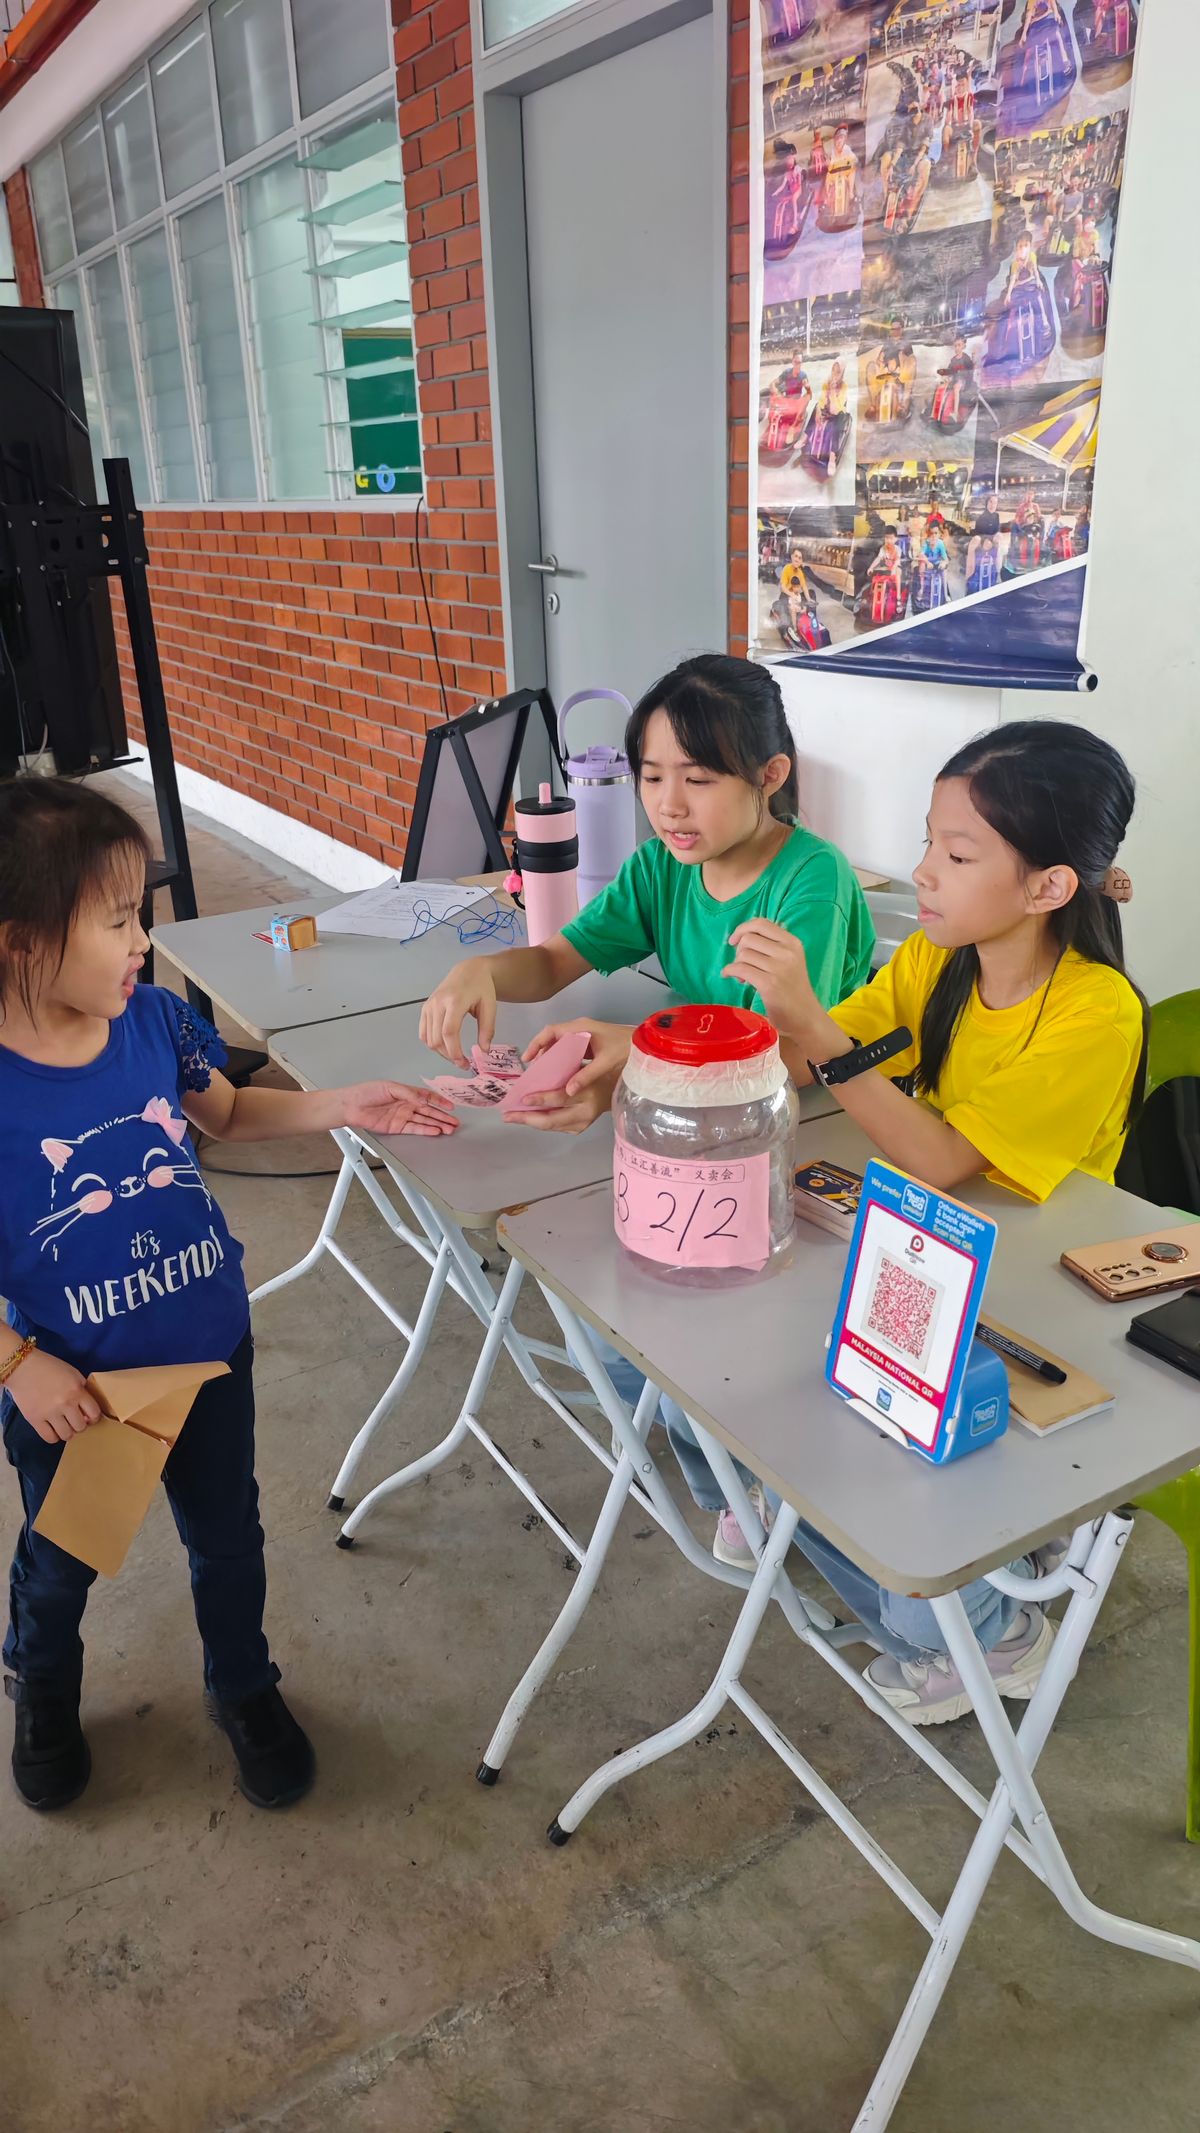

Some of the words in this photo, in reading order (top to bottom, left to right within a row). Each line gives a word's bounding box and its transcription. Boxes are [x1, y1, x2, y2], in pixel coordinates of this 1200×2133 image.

[937, 1200, 957, 1216] Other
[956, 1212, 986, 1232] eWallets
[130, 1229, 161, 1259] it's
[64, 1224, 225, 1324] WEEKEND!
[851, 1337, 885, 1366] MALAYSIA
[884, 1360, 921, 1391] NATIONAL
[921, 1385, 934, 1399] QR
